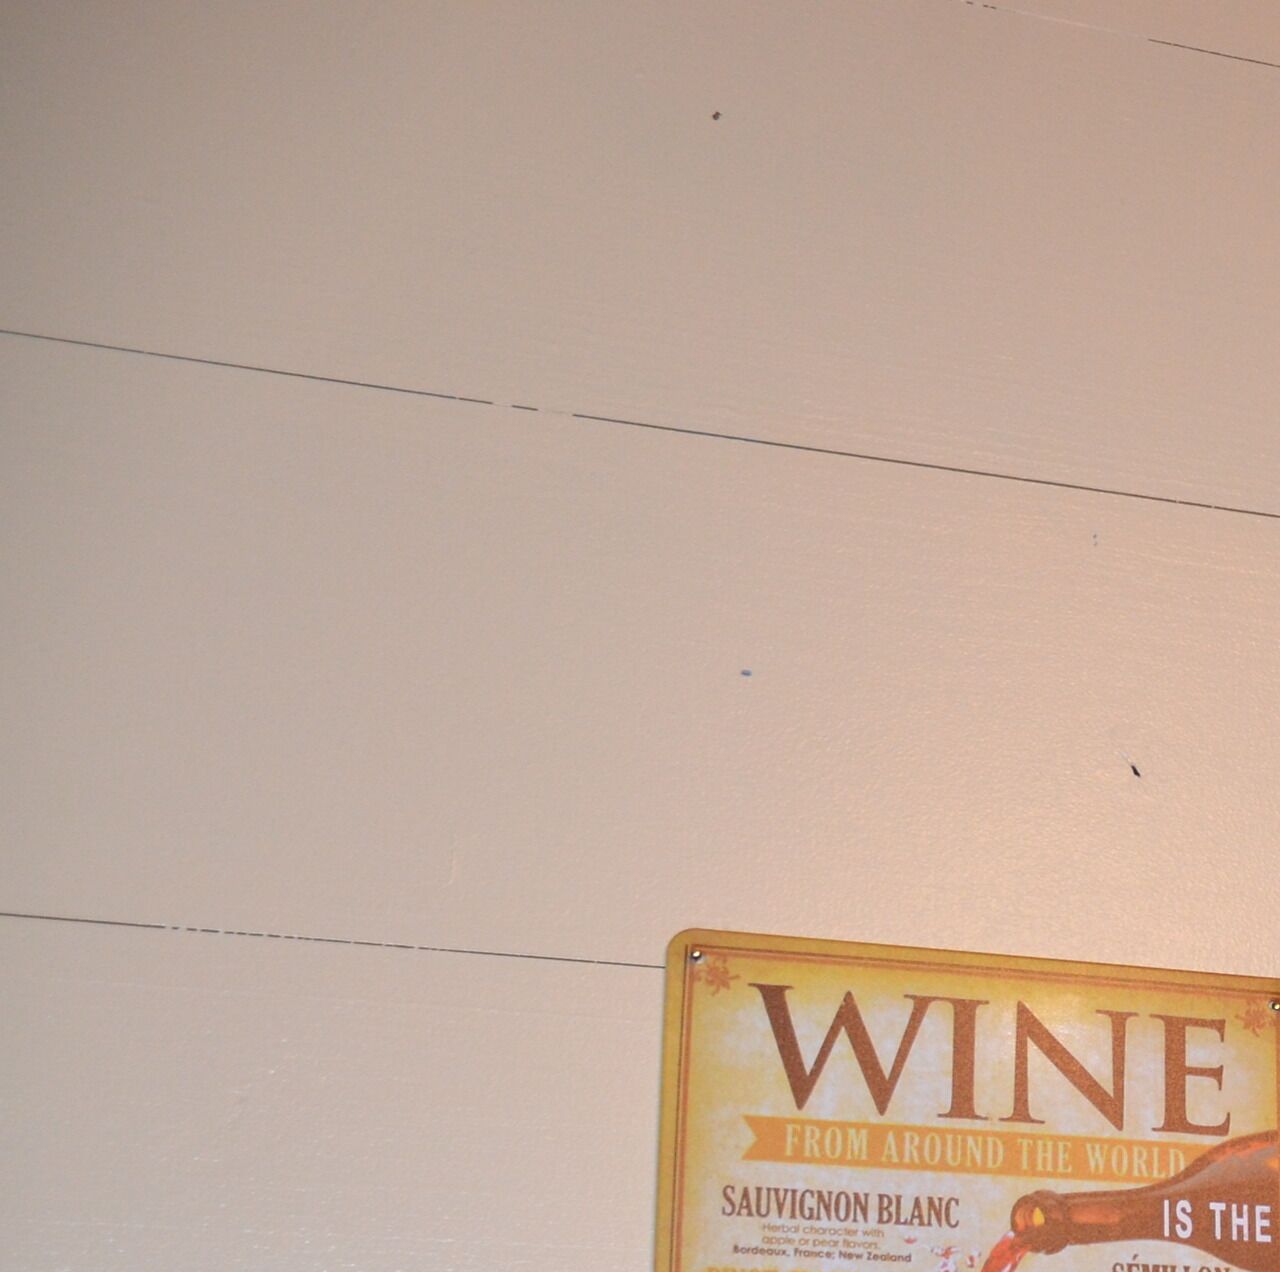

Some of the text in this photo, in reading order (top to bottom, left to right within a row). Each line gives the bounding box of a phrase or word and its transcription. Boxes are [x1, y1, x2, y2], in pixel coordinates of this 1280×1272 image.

[748, 983, 1232, 1137] WINE
[784, 1124, 1186, 1179] FROM AROUND THE WORLD
[722, 1185, 960, 1228] SAUVIGNON BLANC
[1163, 1200, 1272, 1242] IS THE
[838, 1250, 863, 1260] New
[866, 1252, 912, 1262] Zealand
